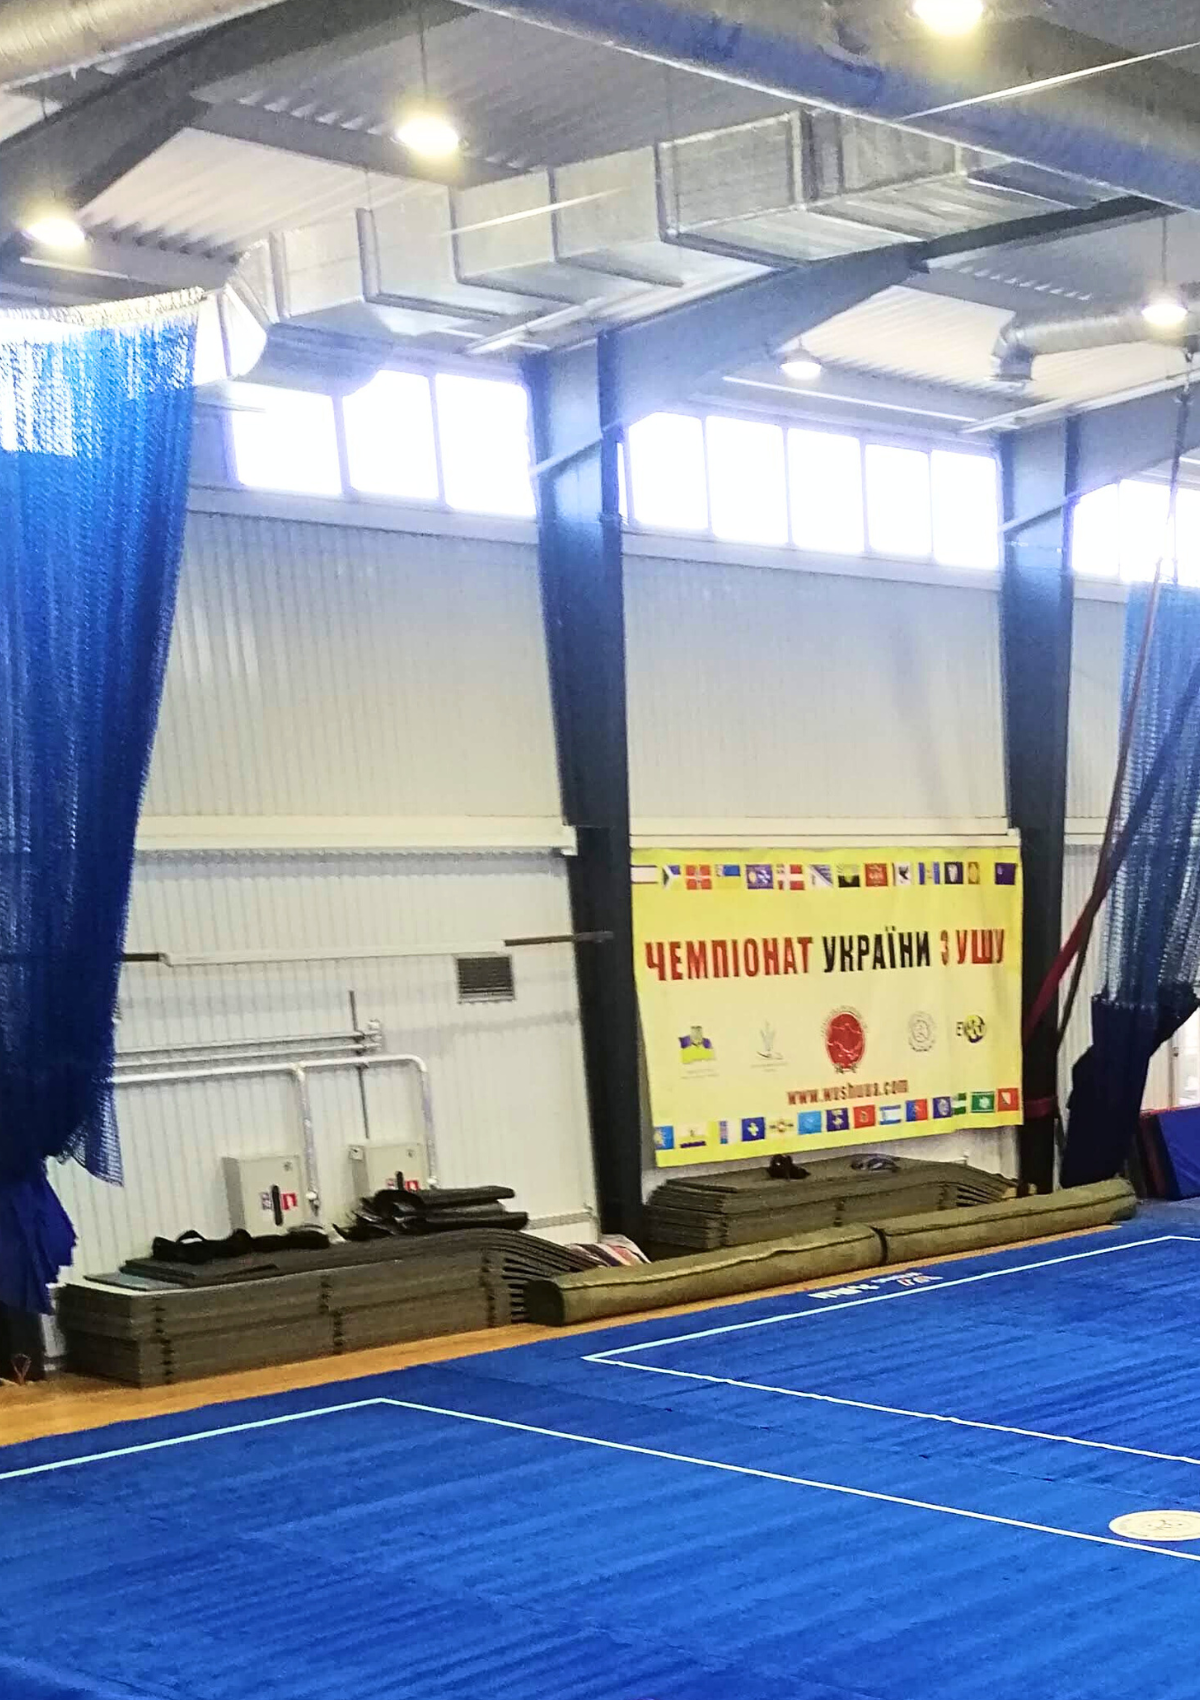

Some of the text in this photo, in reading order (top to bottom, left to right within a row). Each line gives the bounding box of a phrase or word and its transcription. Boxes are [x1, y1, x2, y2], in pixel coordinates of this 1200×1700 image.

[644, 925, 1005, 982] ЧЕМПІОНАТ УКРАЇНИ З УШУ
